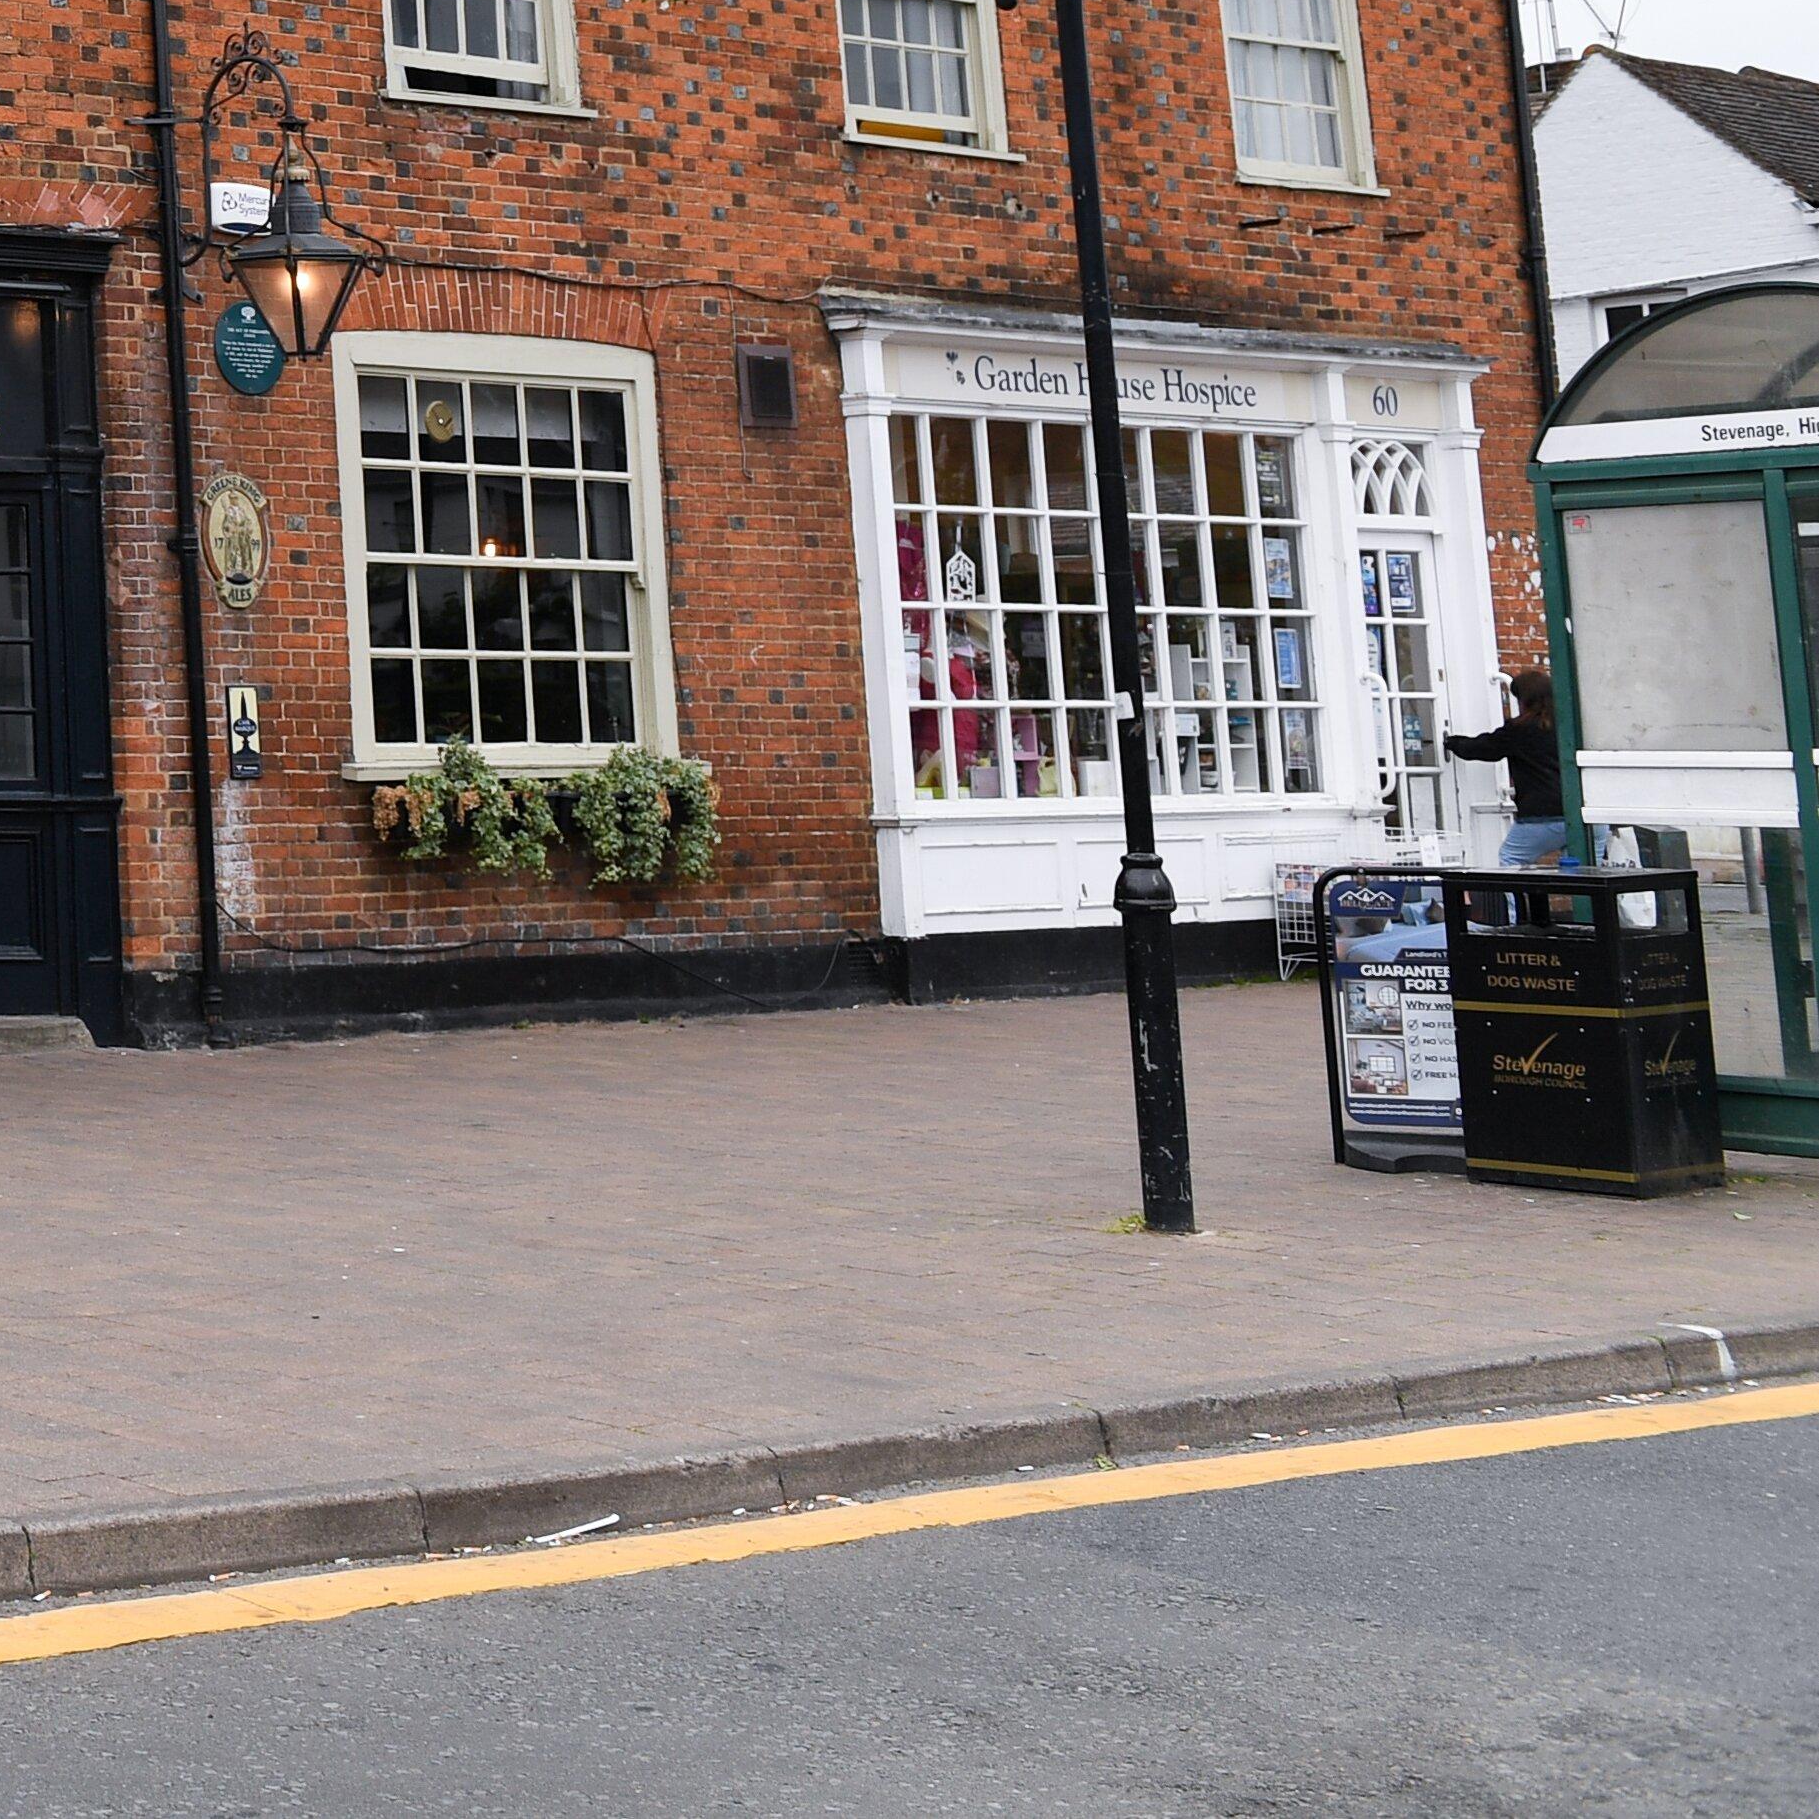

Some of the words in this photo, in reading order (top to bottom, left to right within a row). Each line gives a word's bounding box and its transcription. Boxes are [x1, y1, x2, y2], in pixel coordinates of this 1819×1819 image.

[239, 192, 269, 205] Mercur
[974, 354, 1069, 397] Garden
[1073, 361, 1157, 402] Huse
[1161, 367, 1257, 414] Hospice
[1372, 384, 1399, 417] 60
[1701, 423, 1790, 442] Stevenage,
[207, 477, 237, 501] GREENE
[238, 478, 261, 504] KING
[228, 587, 252, 602] ALES
[1496, 952, 1547, 967] LITTER
[1550, 955, 1562, 967] &
[1360, 964, 1451, 979] GUARANTEE
[1404, 978, 1437, 992] FOR
[1487, 975, 1521, 989] DOG
[1522, 977, 1577, 992] WASTE
[1405, 999, 1433, 1012] Why
[1422, 1021, 1436, 1029] NO
[1437, 1021, 1456, 1030] FEE
[1423, 1038, 1437, 1046] NO
[1424, 1055, 1438, 1063] NO
[1425, 1071, 1447, 1079] FREE
[1493, 1074, 1544, 1088] BOROUGH
[1545, 1077, 1588, 1091] COUNCIL
